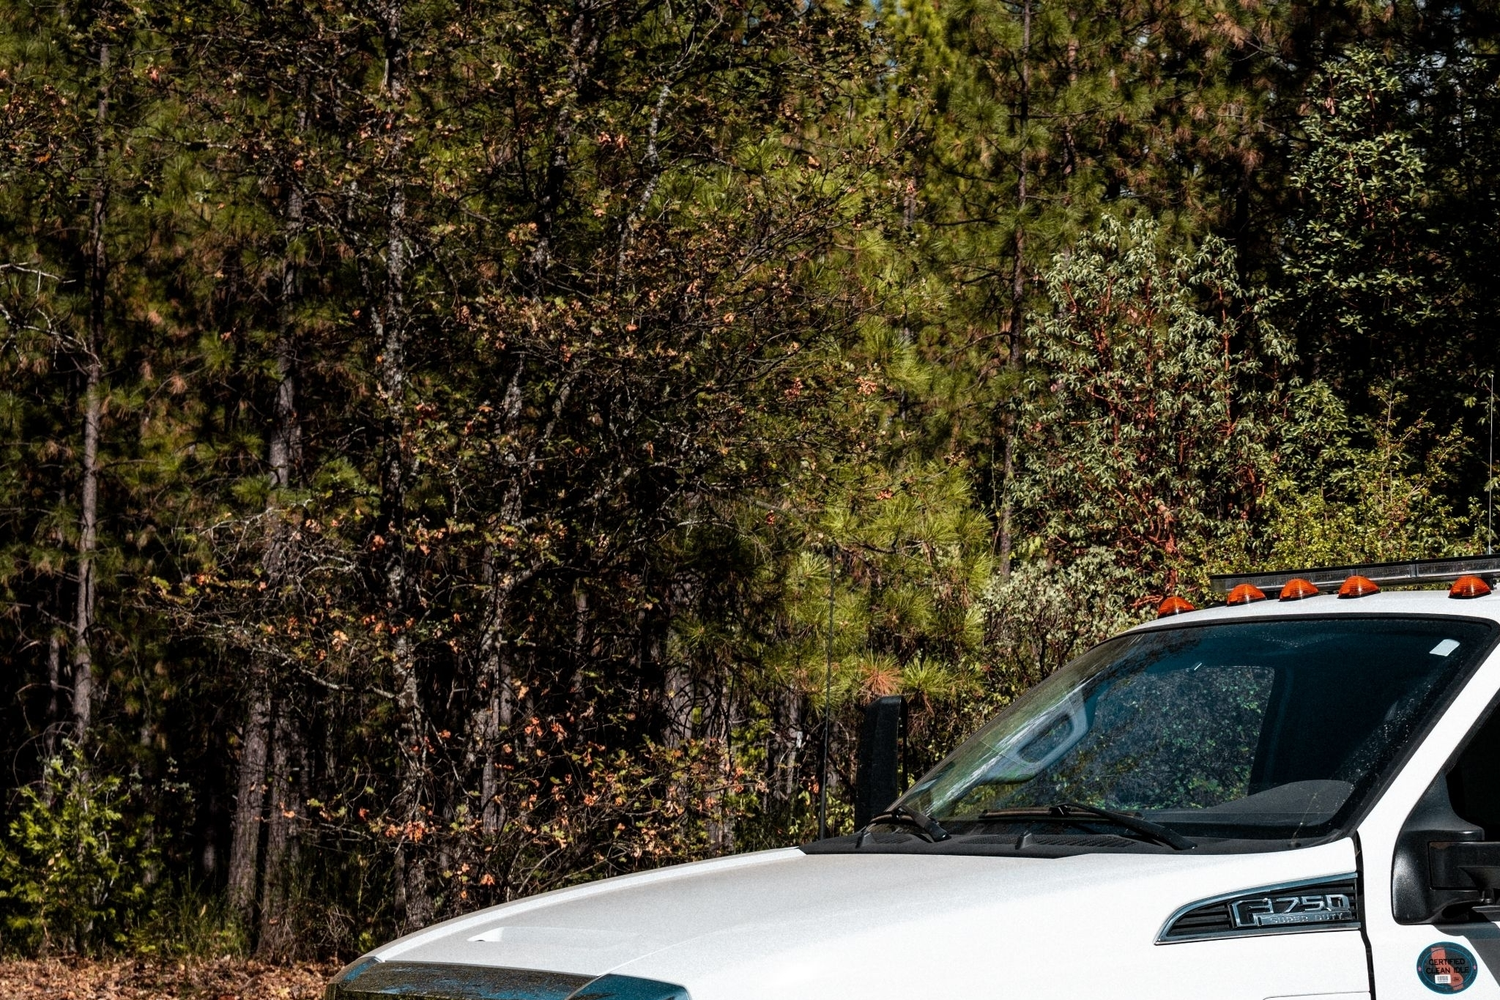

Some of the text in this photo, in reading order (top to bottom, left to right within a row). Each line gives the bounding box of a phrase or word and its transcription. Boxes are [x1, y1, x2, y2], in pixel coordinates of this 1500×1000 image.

[1271, 912, 1343, 924] SUPER DUTY
[1429, 958, 1466, 966] CERTIFIED
[1426, 966, 1470, 975] CLEAN IDLE
